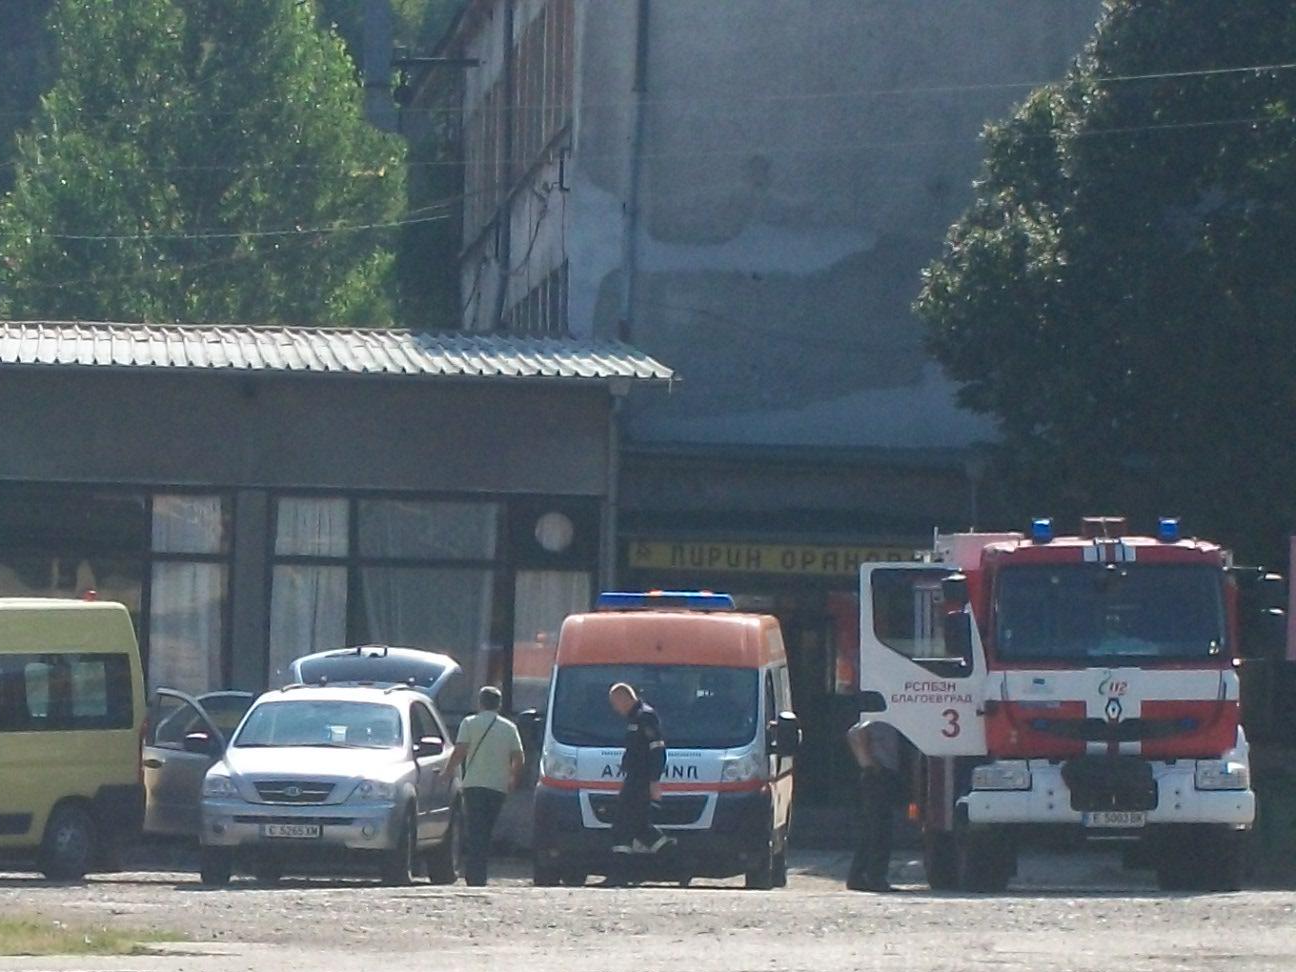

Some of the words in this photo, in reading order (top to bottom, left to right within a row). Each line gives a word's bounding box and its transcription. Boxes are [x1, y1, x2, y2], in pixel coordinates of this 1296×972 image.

[672, 545, 761, 570] ПИРИН
[904, 681, 956, 692] РСПБЗН
[891, 694, 973, 704] БЛАГОЕВГРАД
[941, 708, 961, 738] 3
